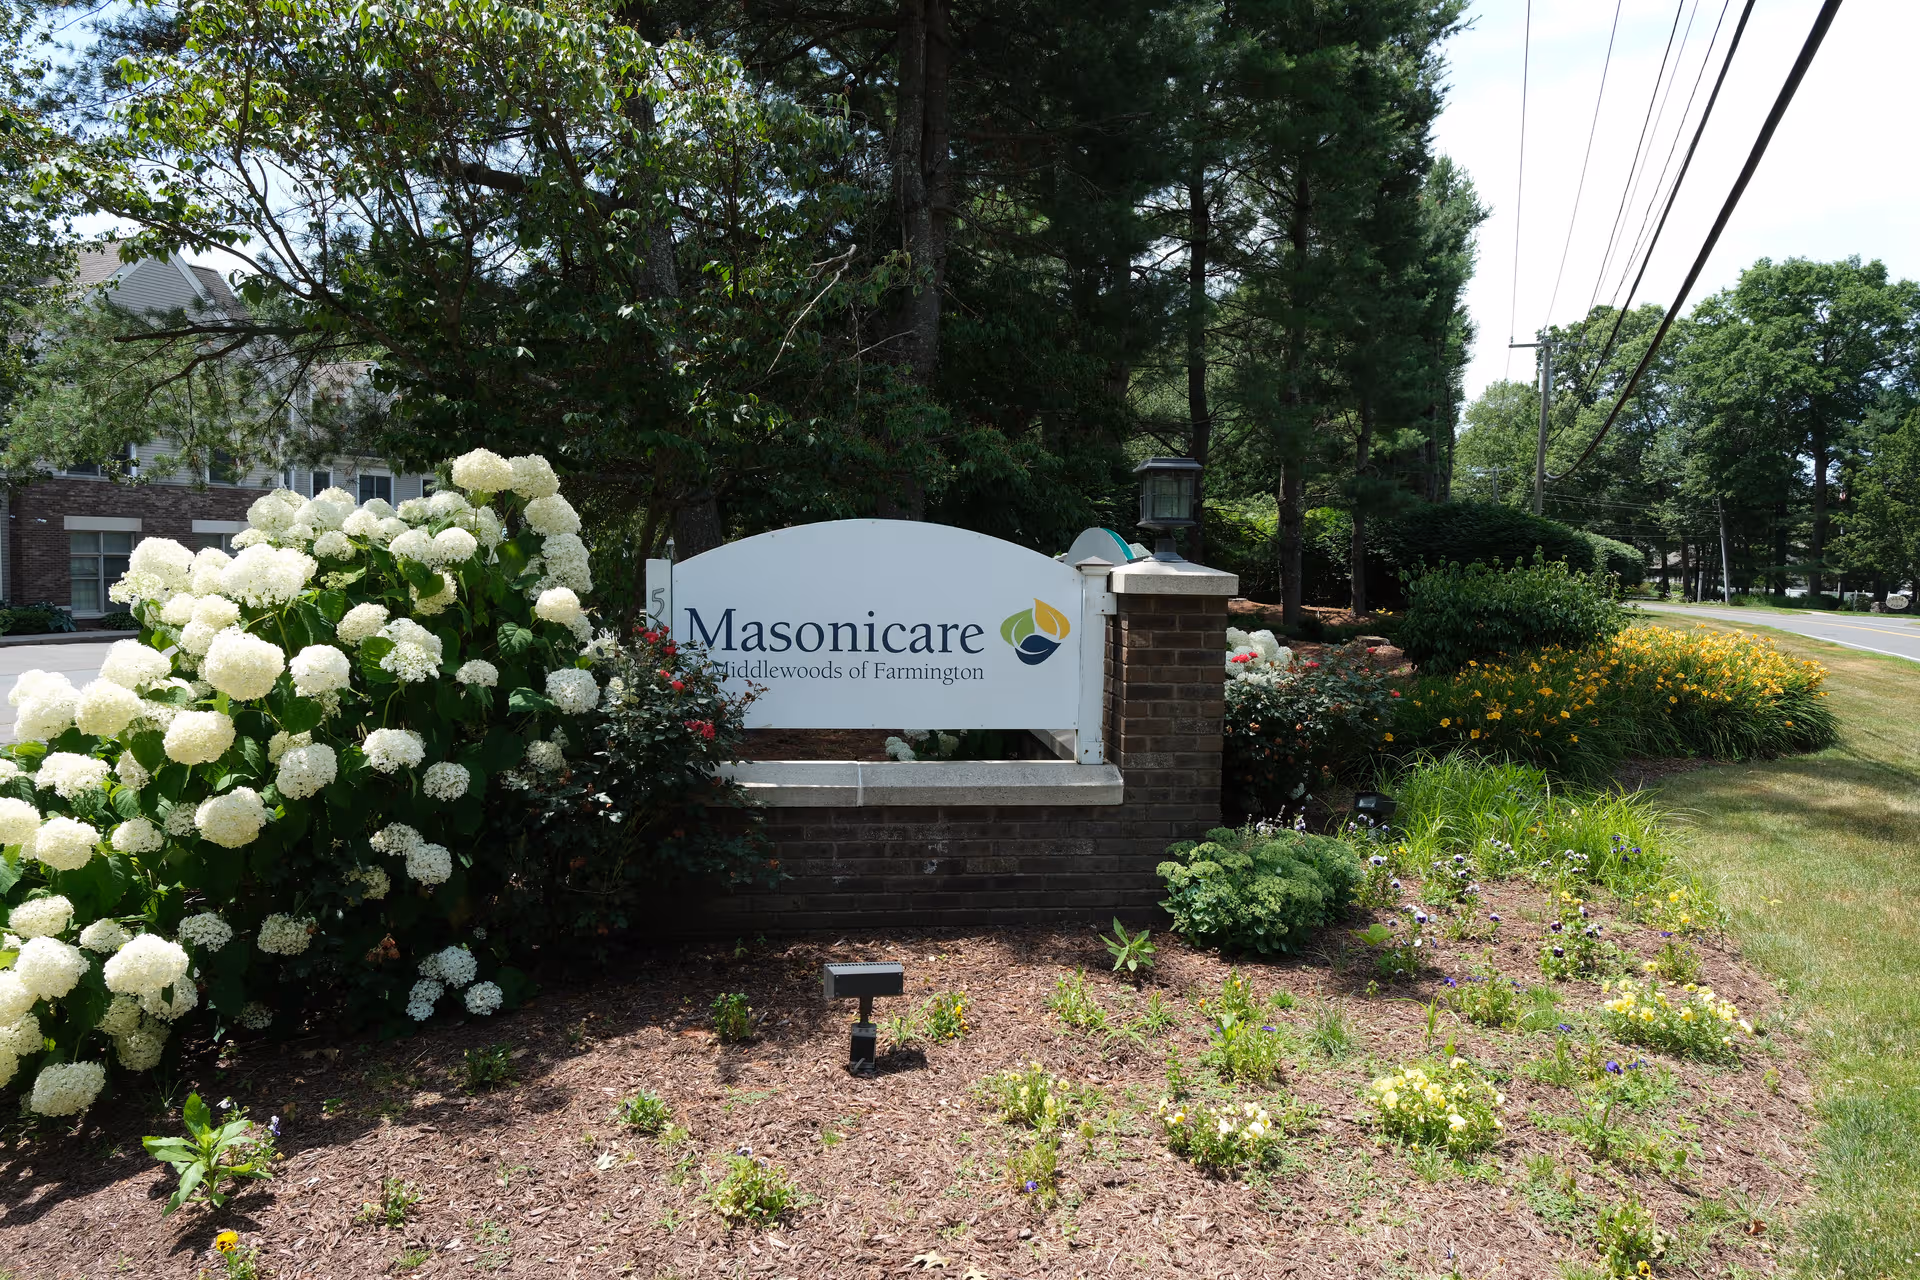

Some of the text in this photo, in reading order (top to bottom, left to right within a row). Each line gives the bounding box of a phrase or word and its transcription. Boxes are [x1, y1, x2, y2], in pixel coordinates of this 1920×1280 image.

[684, 607, 985, 655] Masonicare
[711, 659, 984, 685] Middlewoods of Farmington
